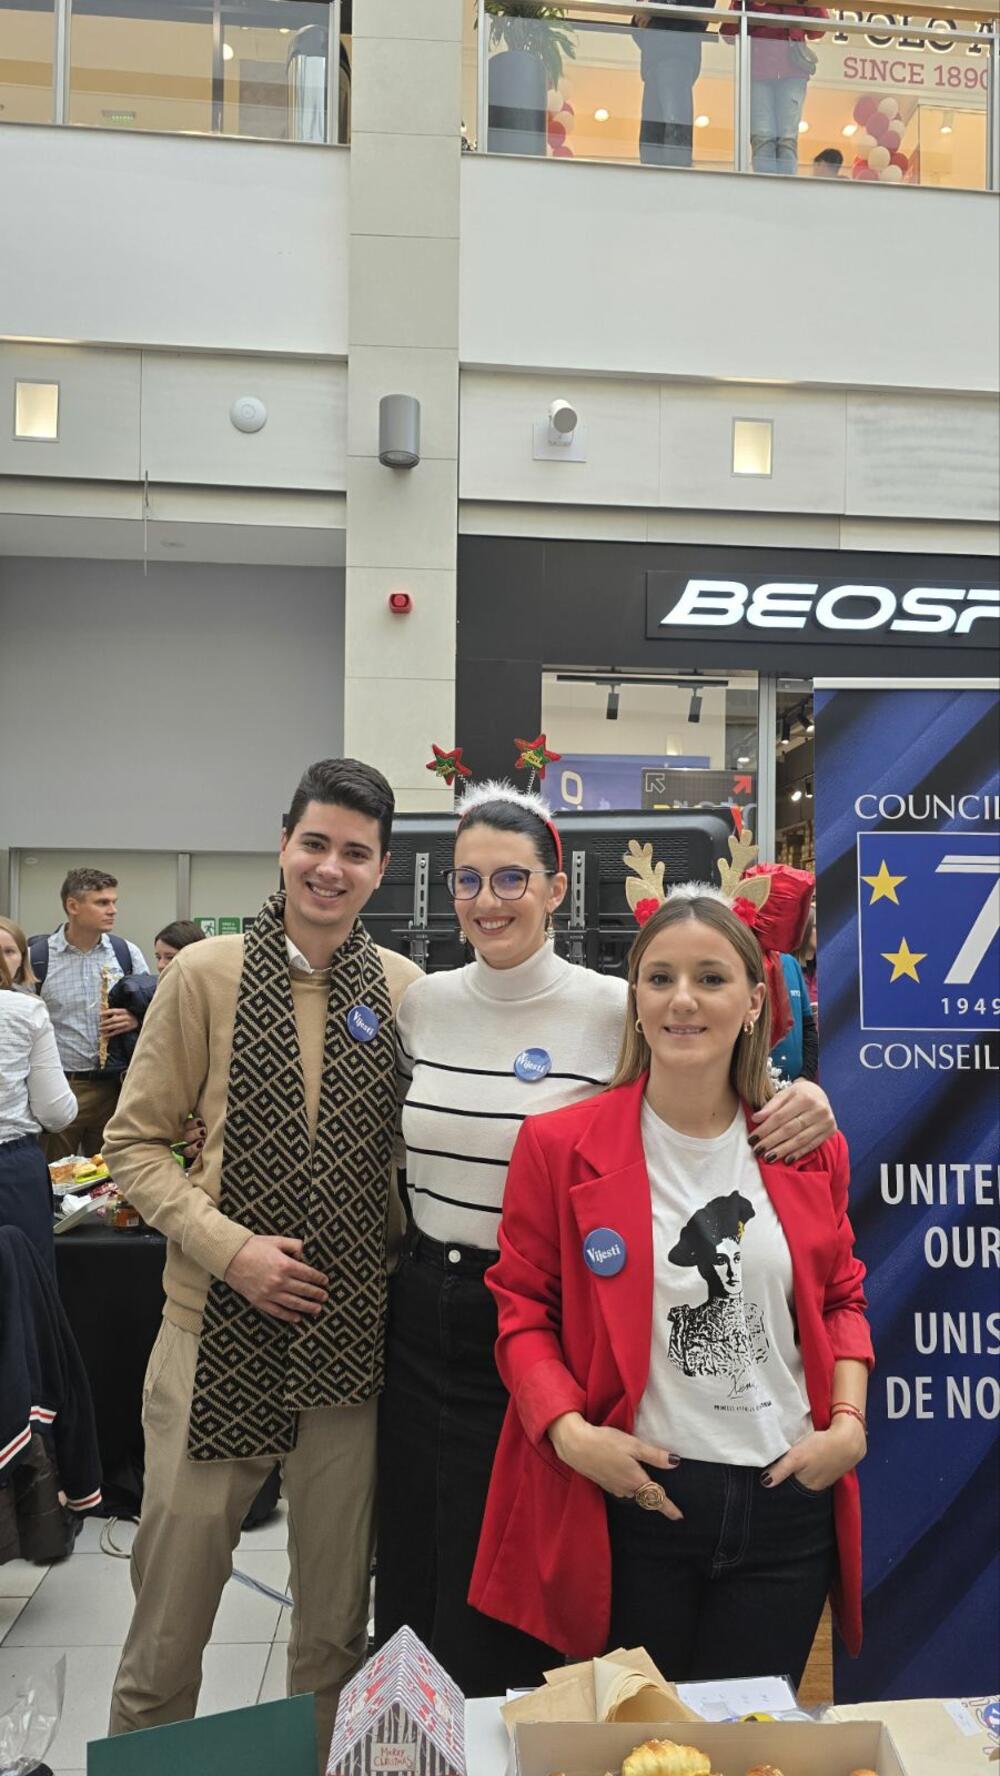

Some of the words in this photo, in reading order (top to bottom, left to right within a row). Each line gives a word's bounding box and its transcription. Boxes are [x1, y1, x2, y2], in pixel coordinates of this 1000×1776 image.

[843, 57, 924, 85] SINCE
[855, 794, 1000, 820] COUNCIL
[941, 997, 1000, 1015] 1949
[859, 1043, 1000, 1070] CONSEIL
[880, 1163, 1000, 1205] UNITE
[587, 1244, 621, 1263] Vijesti
[924, 1226, 1000, 1268] OUR
[914, 1312, 1000, 1355] UNIS
[886, 1376, 934, 1419] DE
[947, 1375, 1000, 1420] NO
